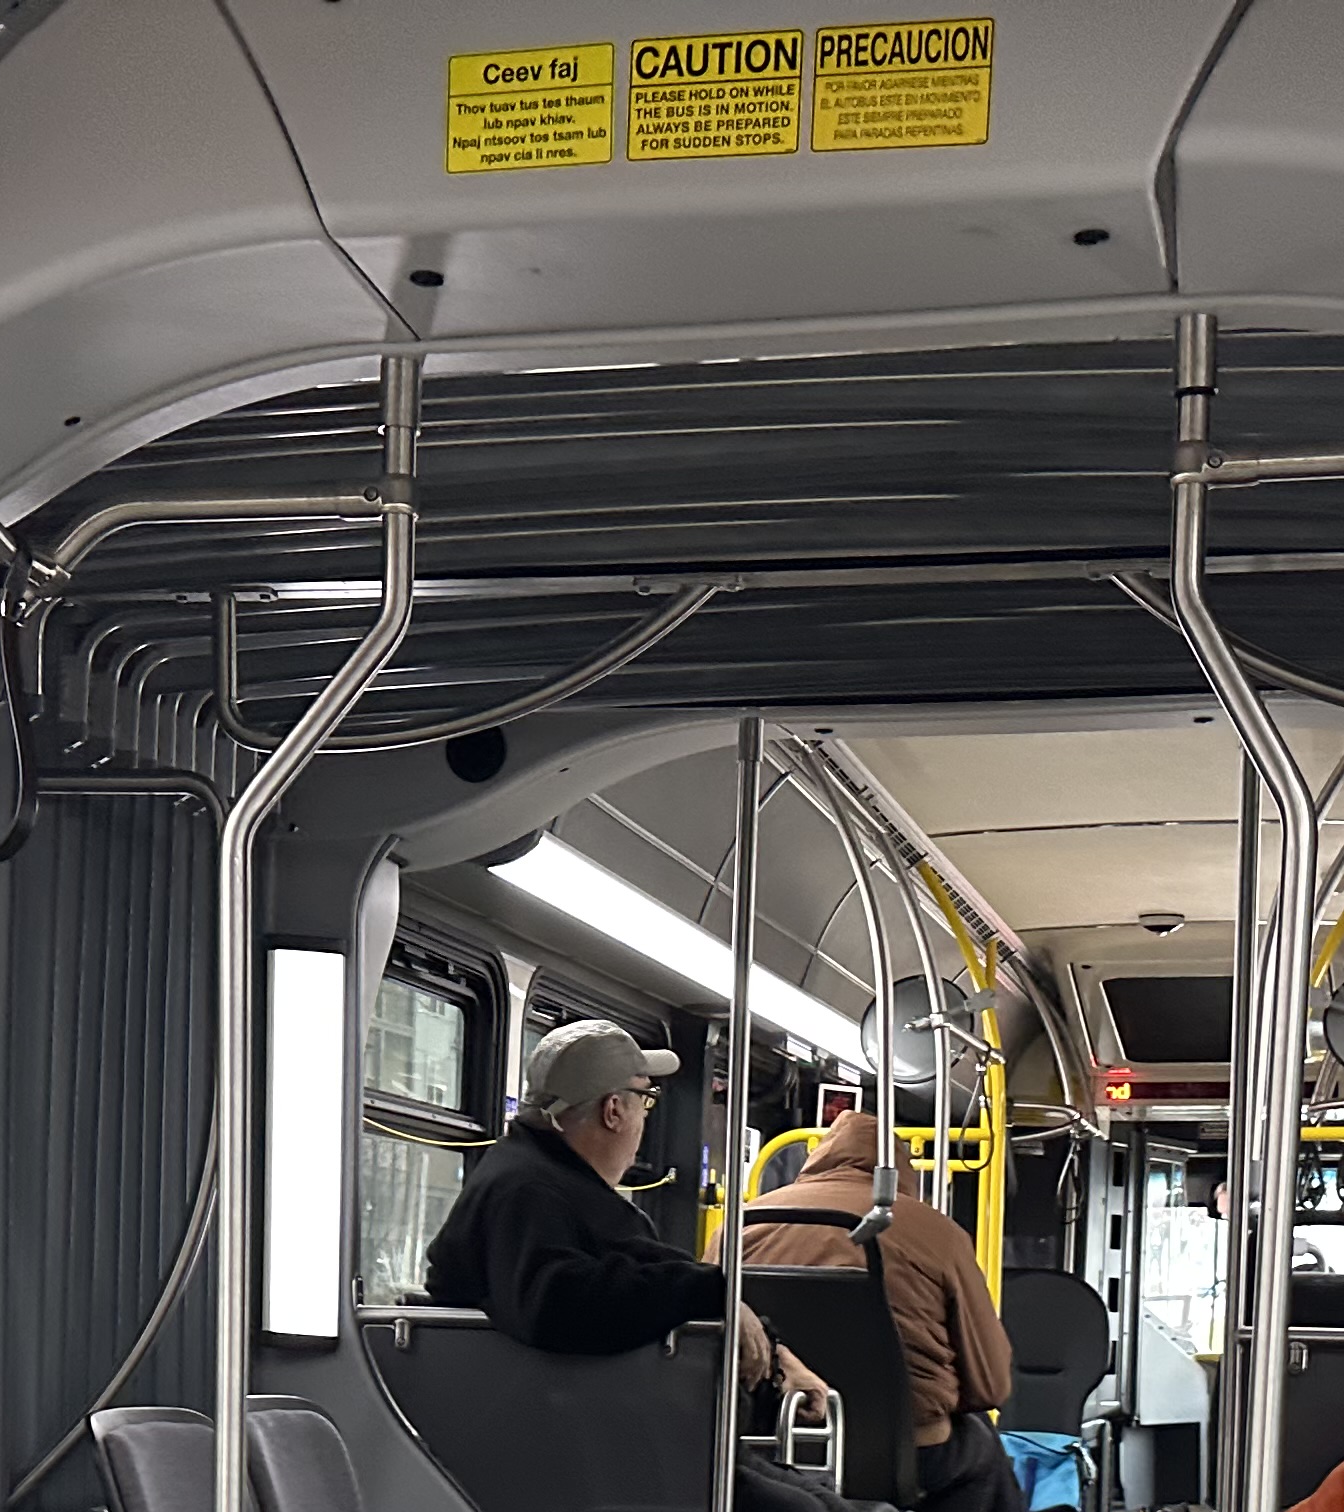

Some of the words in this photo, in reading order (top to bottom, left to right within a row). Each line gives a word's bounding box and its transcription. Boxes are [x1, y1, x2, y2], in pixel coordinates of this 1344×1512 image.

[819, 26, 989, 69] PRECAUCION
[635, 37, 798, 80] CAUTION
[483, 63, 543, 85] Ceev
[549, 56, 579, 82] faj
[635, 90, 686, 104] PLEASE
[689, 87, 726, 101] HOLD
[729, 86, 749, 99] ON
[752, 84, 796, 98] WHILE
[457, 103, 486, 115] Thov
[520, 99, 539, 111] tus
[565, 94, 605, 107] thaum
[636, 106, 662, 120] THE
[666, 105, 695, 118] BUS
[698, 104, 712, 116] IS
[715, 102, 730, 116] IN
[734, 100, 794, 115] MOTION.
[483, 117, 503, 130] lub
[505, 117, 536, 131] npav
[636, 121, 690, 136] ALWAYS
[693, 119, 712, 132] BE
[716, 116, 791, 132] PREPARED
[452, 136, 481, 150] Npaj
[553, 129, 584, 142] tsam
[587, 127, 607, 139] lub
[641, 138, 670, 151] FOR
[673, 135, 731, 149] SUDDEN
[735, 132, 785, 147] STOPS.
[480, 151, 511, 165] npav
